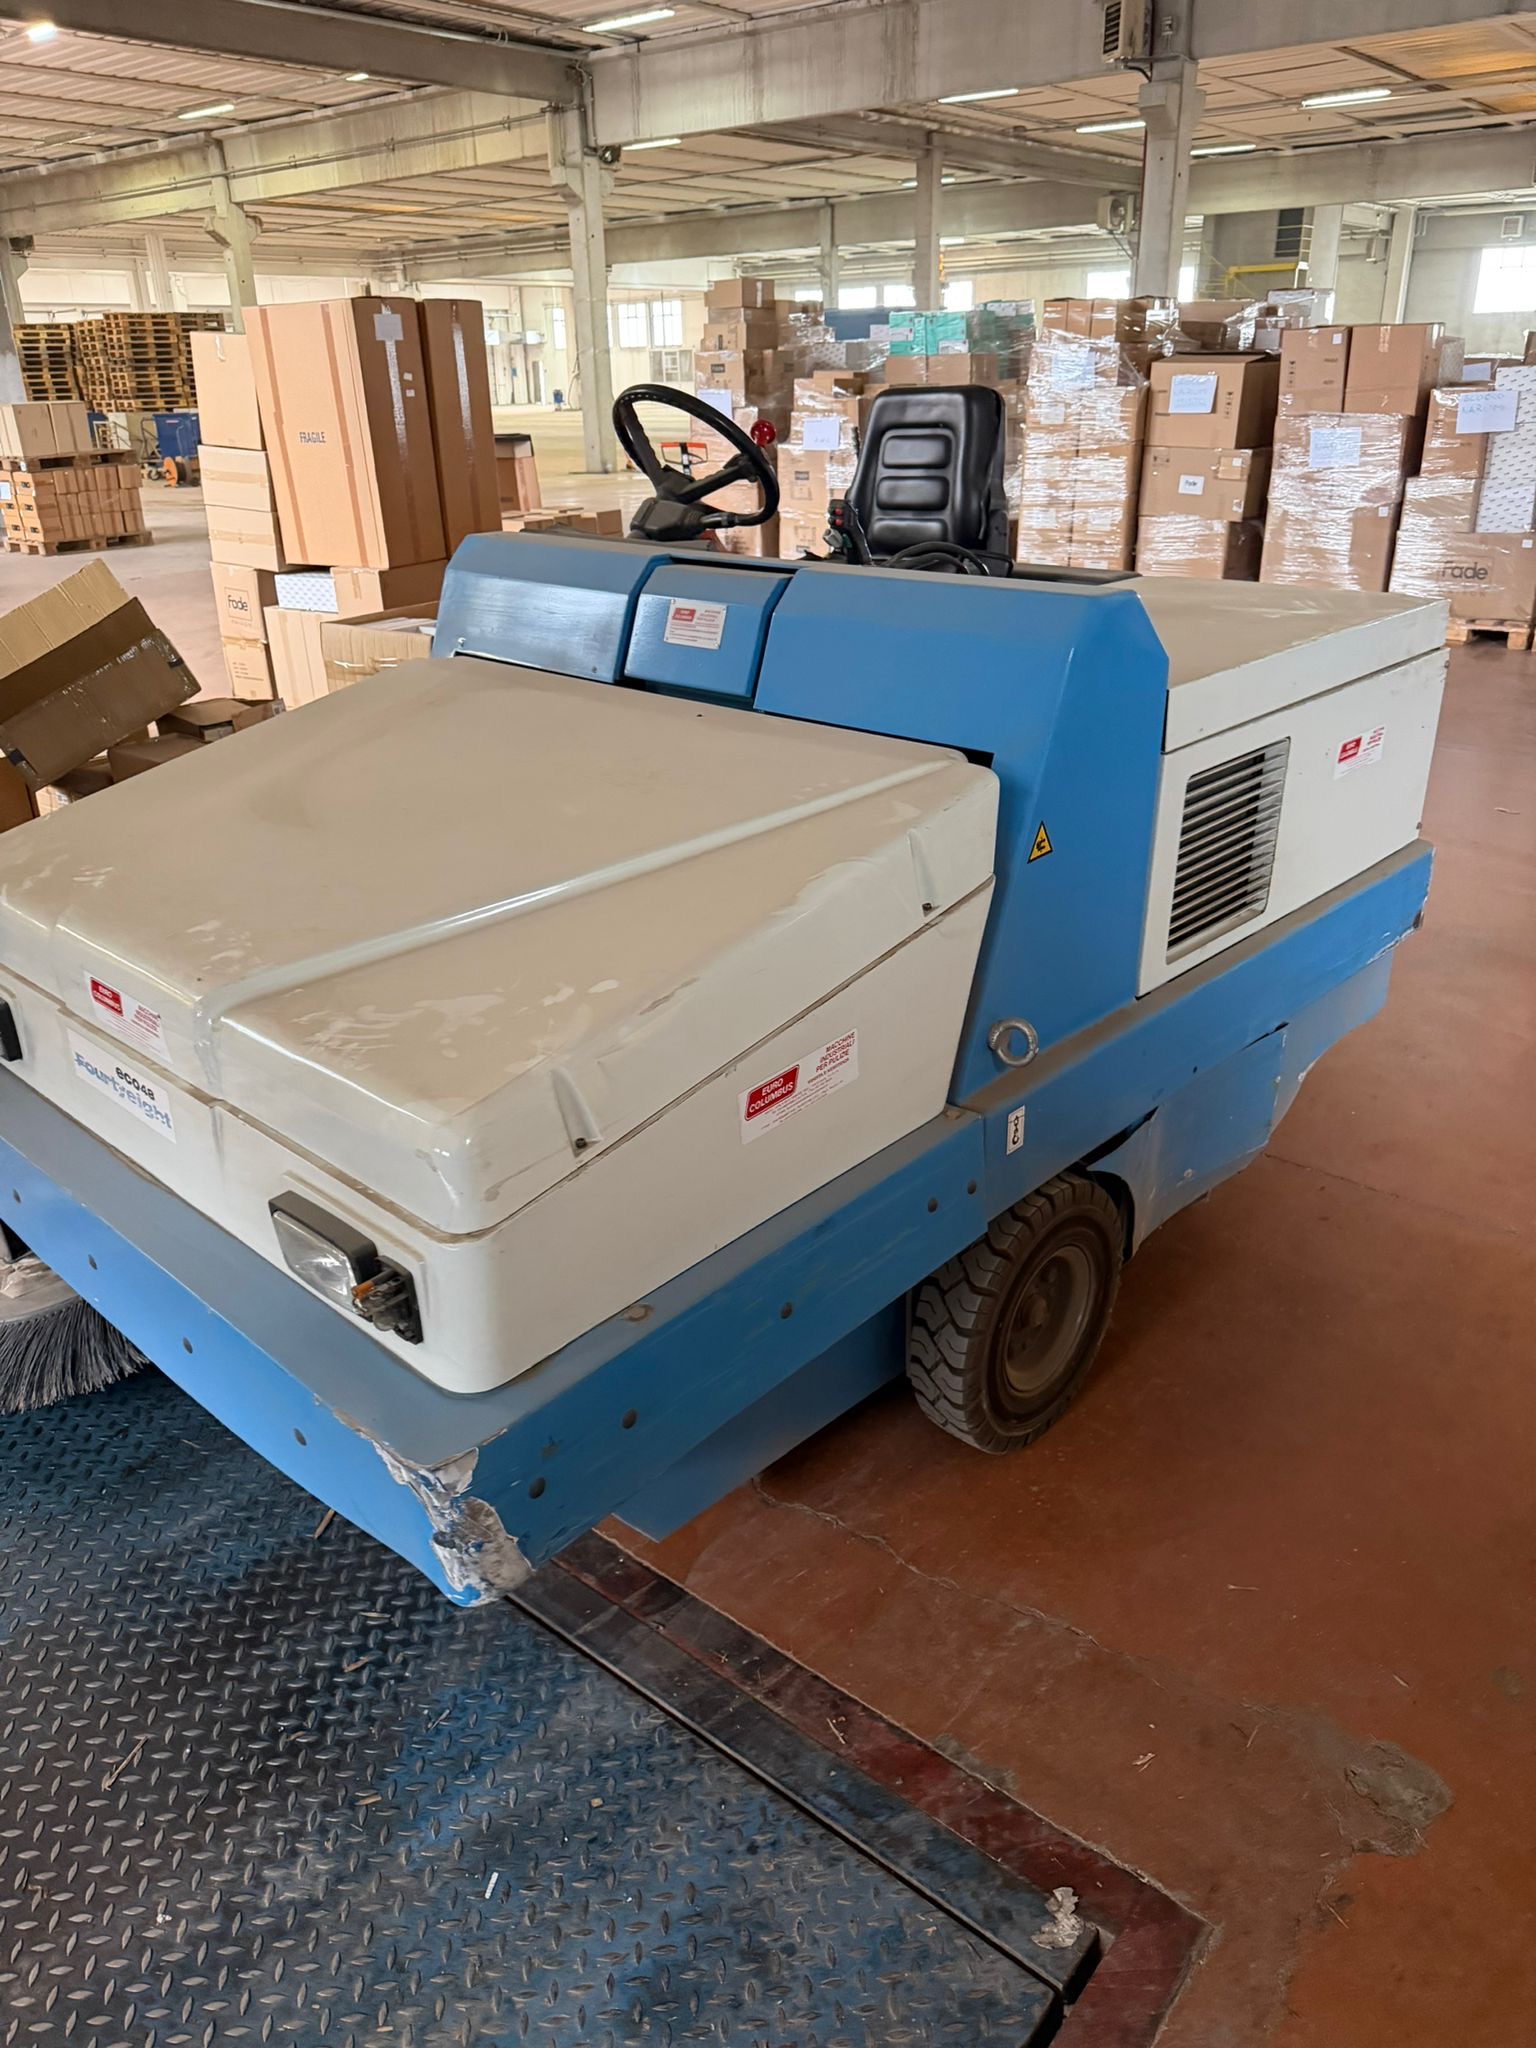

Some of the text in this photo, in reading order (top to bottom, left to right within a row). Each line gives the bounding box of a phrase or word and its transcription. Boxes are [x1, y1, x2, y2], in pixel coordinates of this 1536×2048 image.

[299, 431, 326, 444] FRAGILE
[761, 1077, 784, 1096] EURO
[748, 1081, 794, 1113] COLUMBUS
